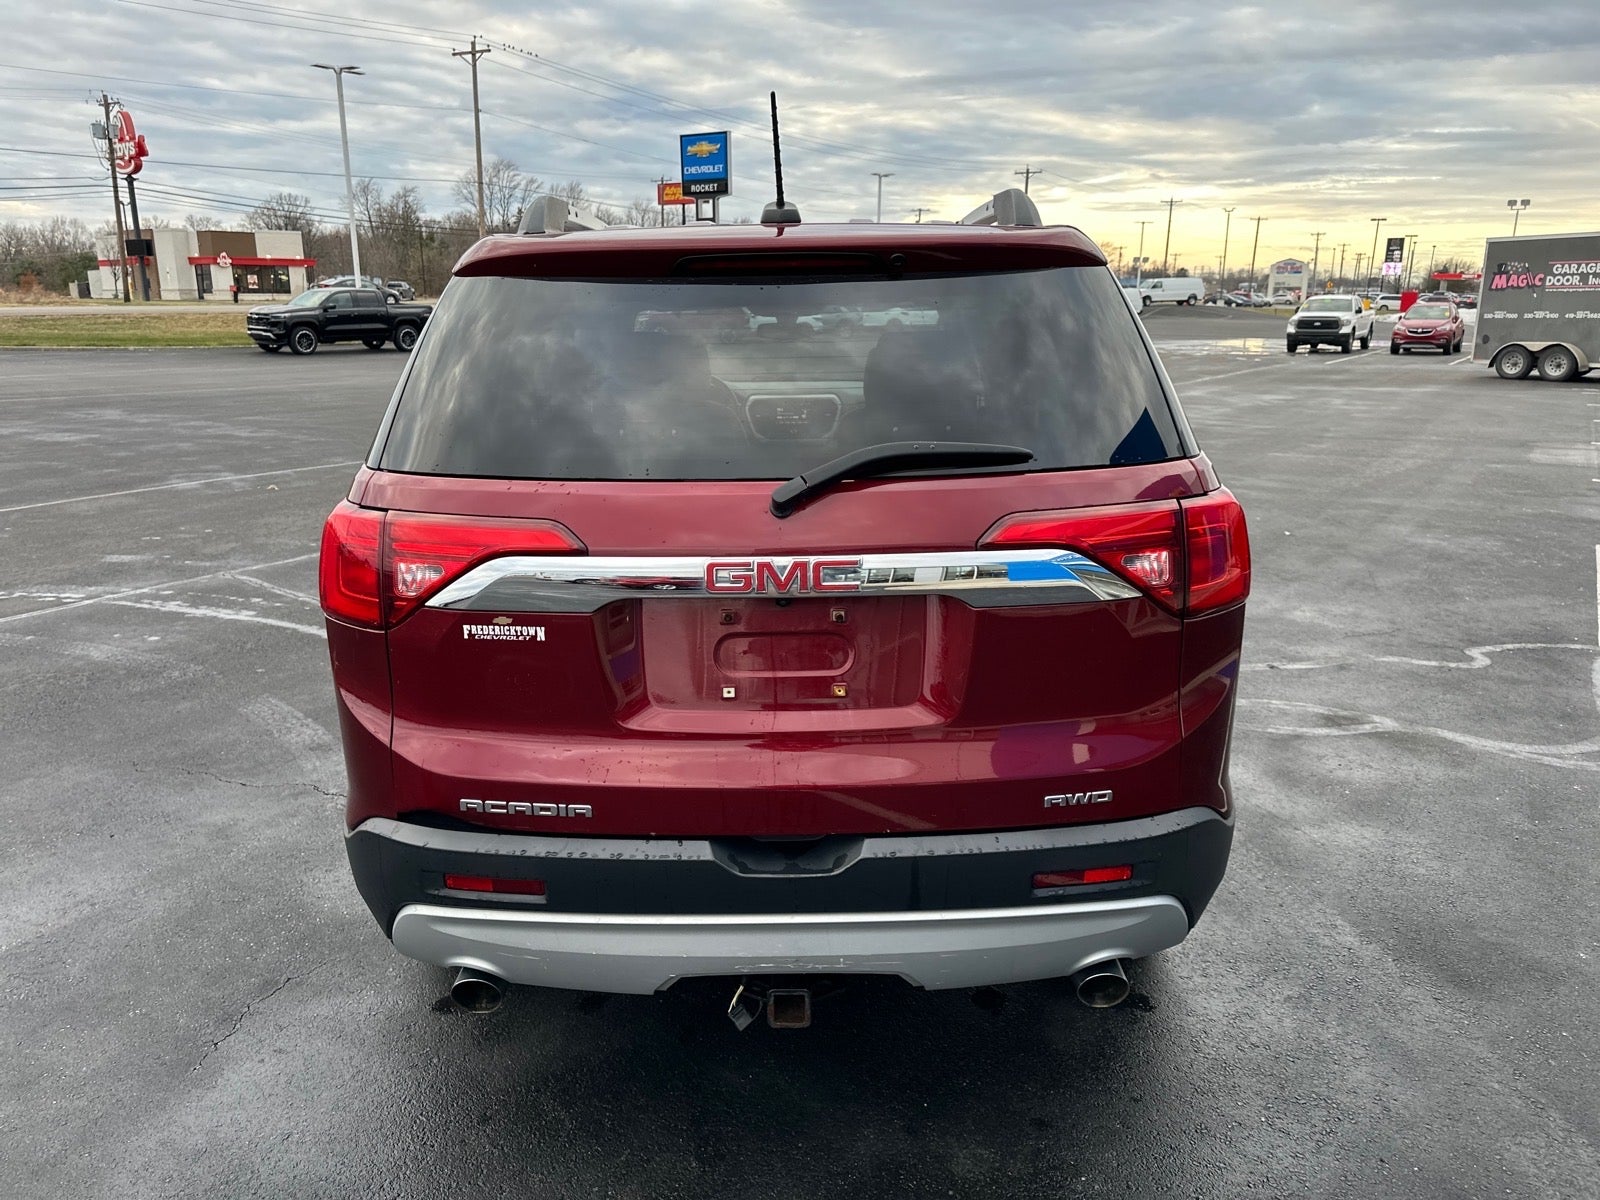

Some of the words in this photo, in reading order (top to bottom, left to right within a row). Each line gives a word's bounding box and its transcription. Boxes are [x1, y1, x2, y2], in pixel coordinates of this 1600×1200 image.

[684, 164, 724, 175] CHEVROLET
[690, 183, 718, 192] ROCKET
[1545, 275, 1583, 286] DOOR,
[705, 557, 864, 593] GMC
[462, 624, 546, 641] FREDERICKTOWN
[1044, 789, 1113, 808] AWD
[459, 798, 593, 818] ACADIA
